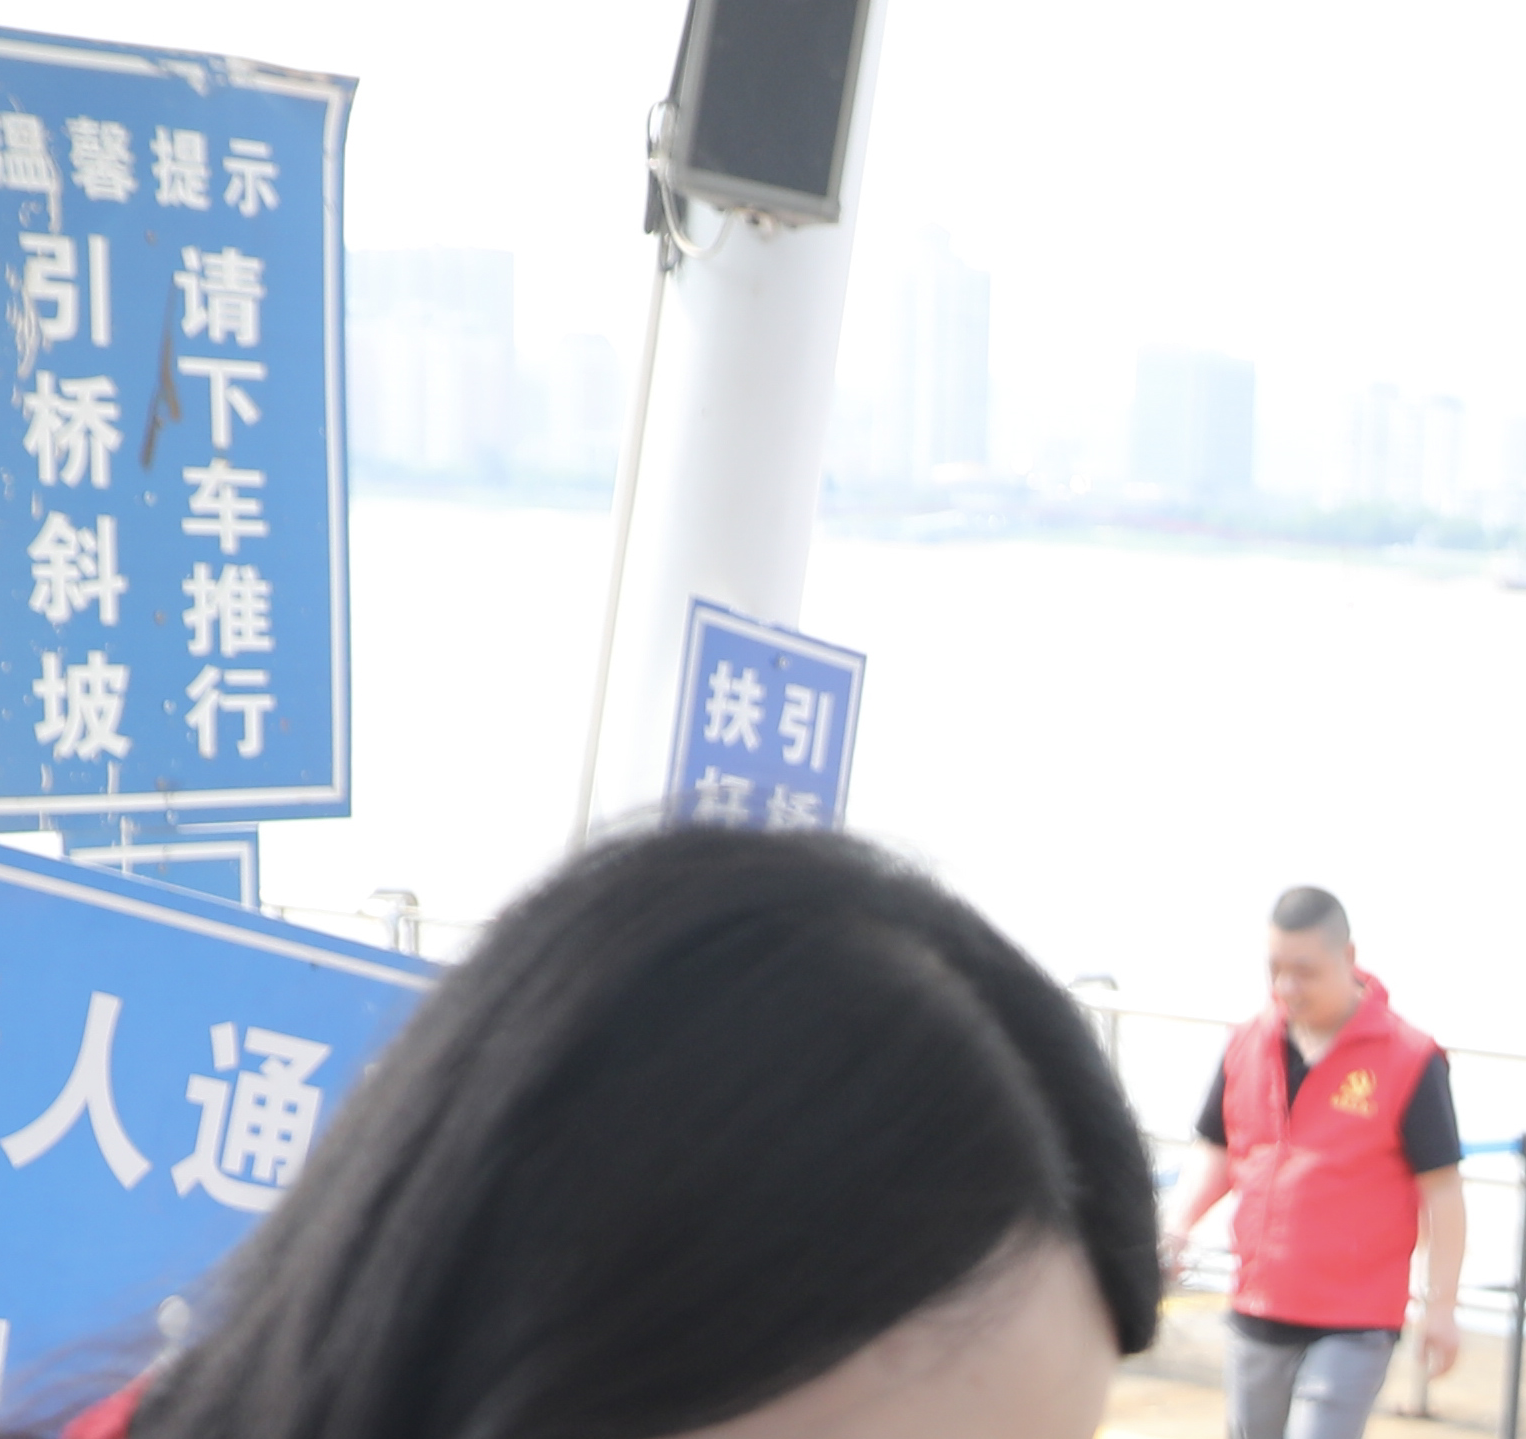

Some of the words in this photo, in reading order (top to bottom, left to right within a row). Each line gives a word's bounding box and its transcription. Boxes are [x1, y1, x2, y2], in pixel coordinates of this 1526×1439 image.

[17, 231, 131, 762] 引桥斜坡
[173, 245, 276, 758] 请下车推行
